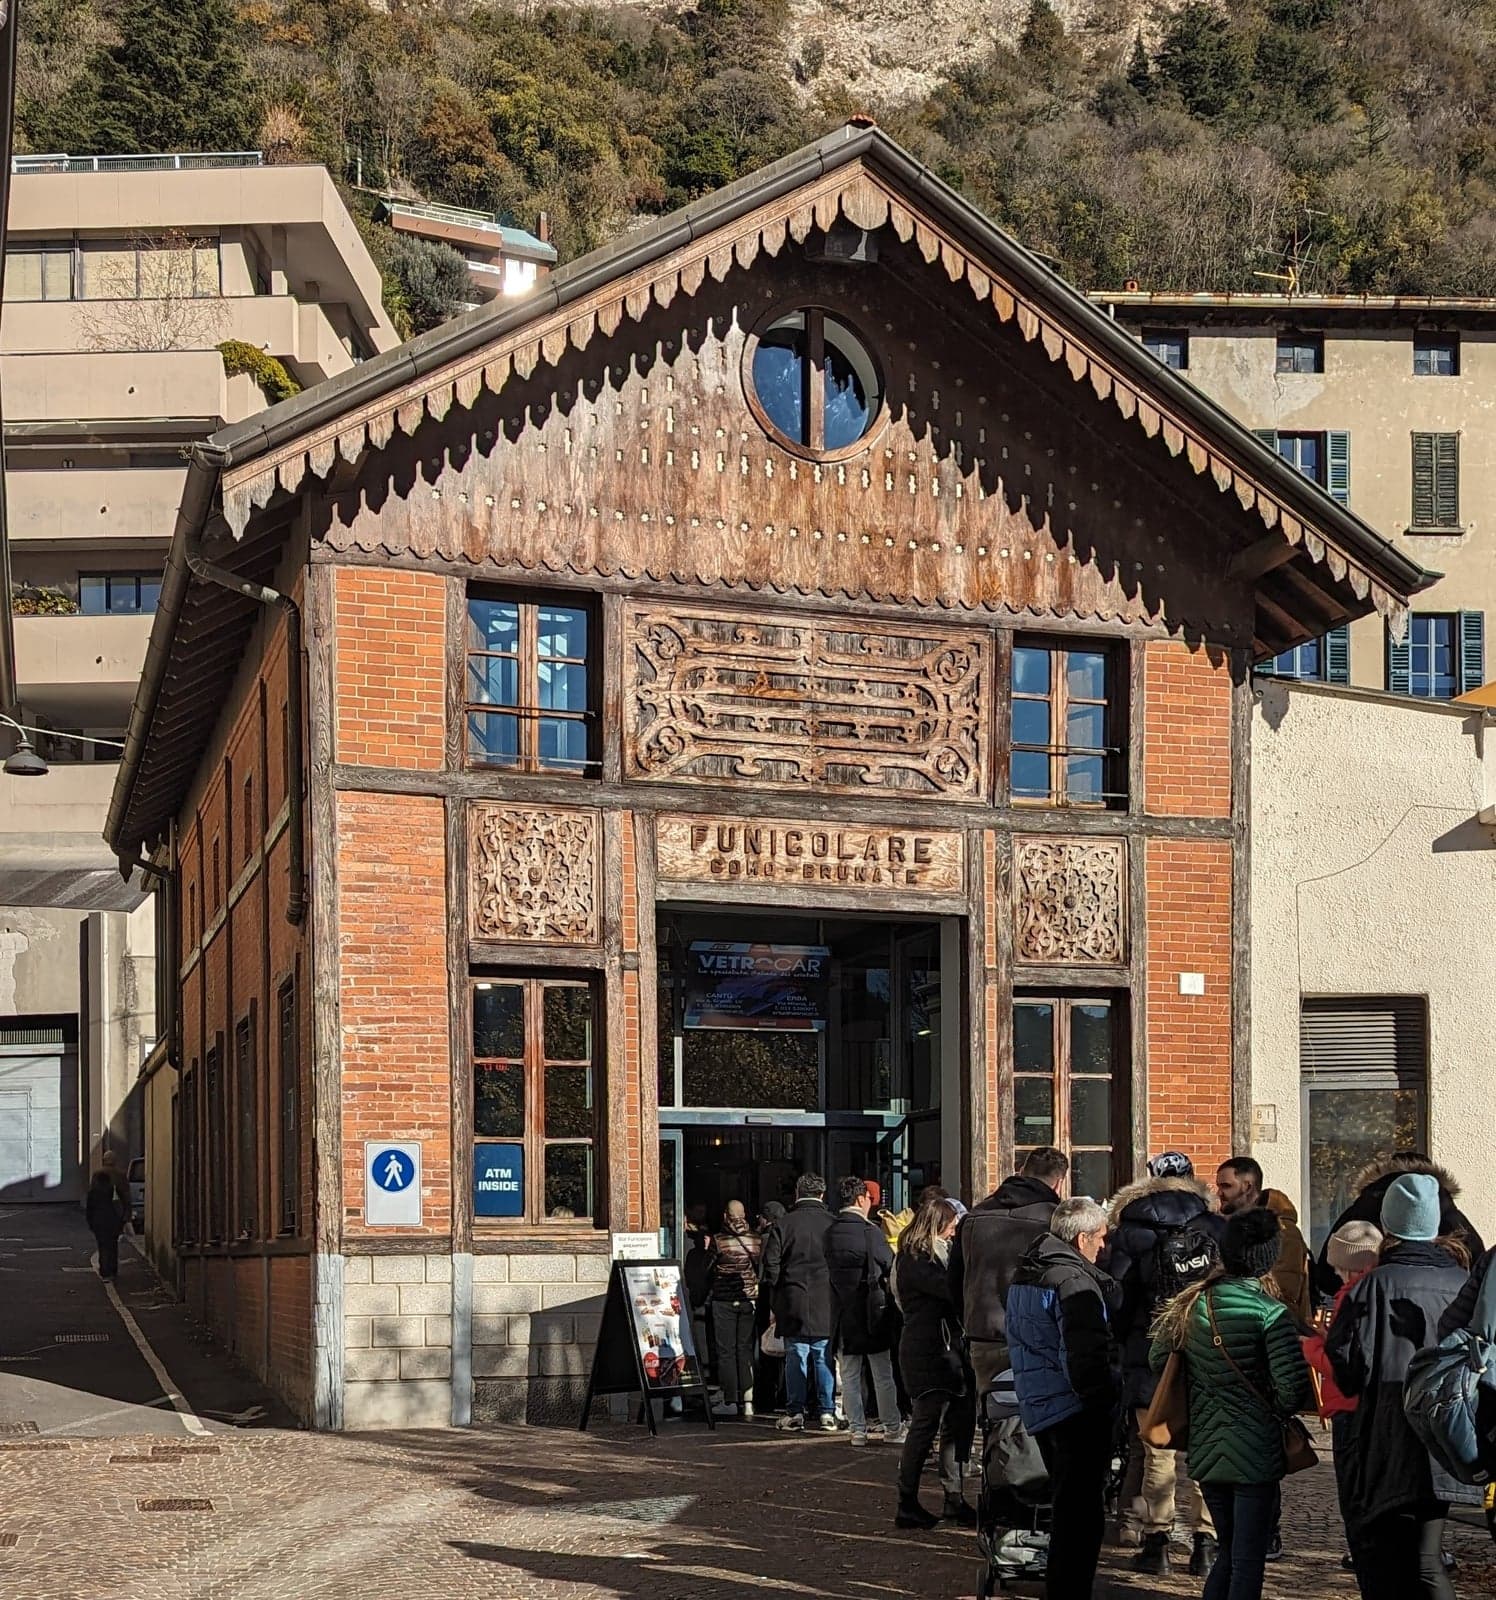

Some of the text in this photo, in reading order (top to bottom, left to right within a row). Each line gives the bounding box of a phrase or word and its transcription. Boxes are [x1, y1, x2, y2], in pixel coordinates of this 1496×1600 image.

[690, 824, 933, 864] FUNICOLARE
[710, 858, 775, 877] COMO
[802, 863, 920, 885] BRUNATE
[484, 1168, 512, 1179] ATM
[478, 1181, 519, 1192] INSIDE
[1175, 1254, 1210, 1273] NASA
